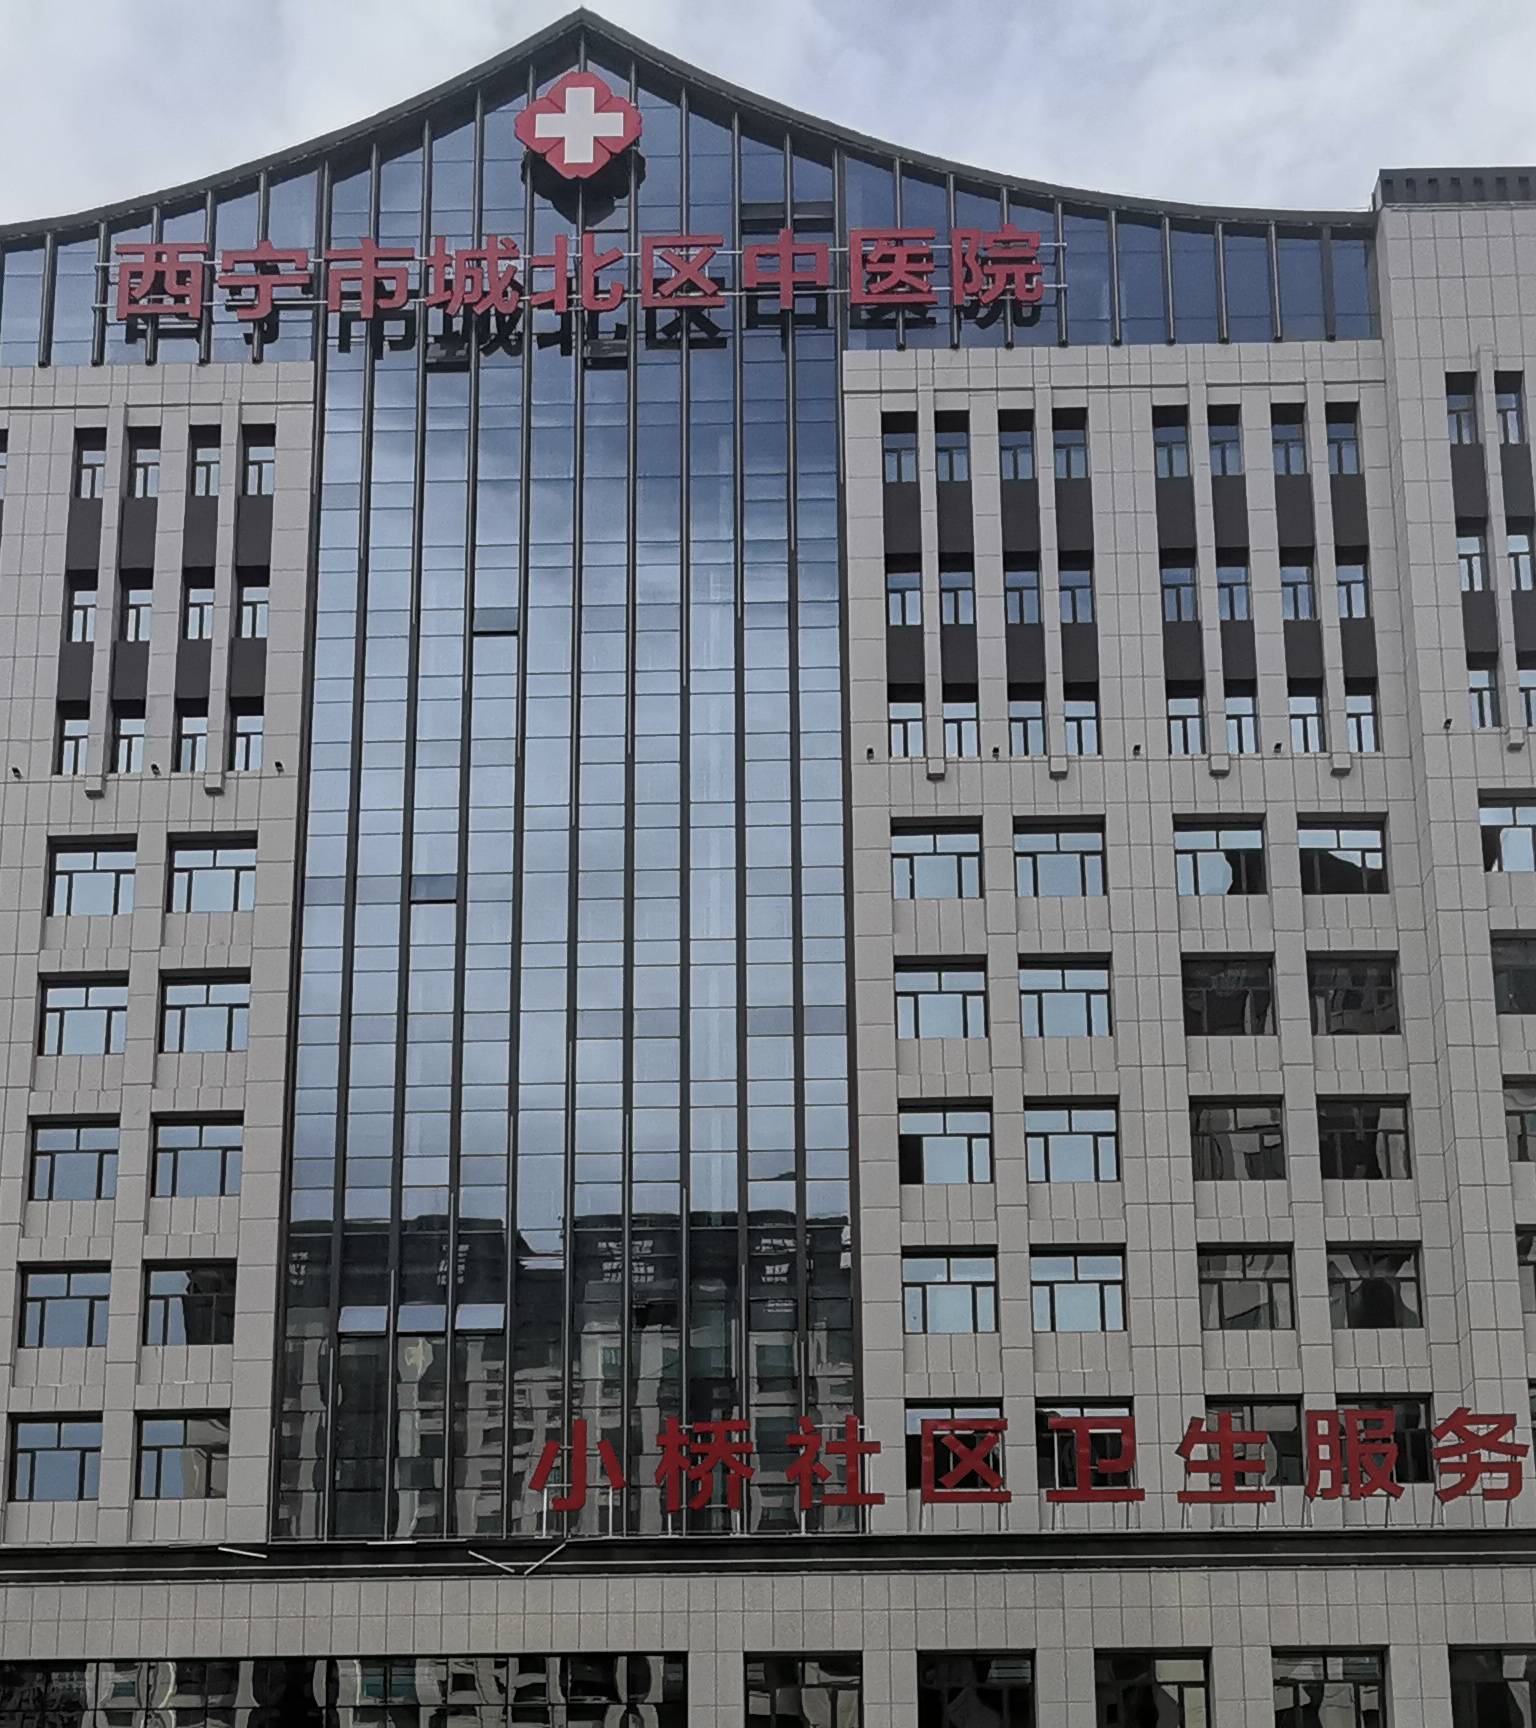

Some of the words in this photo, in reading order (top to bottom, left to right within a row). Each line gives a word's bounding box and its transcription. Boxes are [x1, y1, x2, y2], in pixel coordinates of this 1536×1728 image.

[115, 223, 1046, 320] 西宁市城北区中医院
